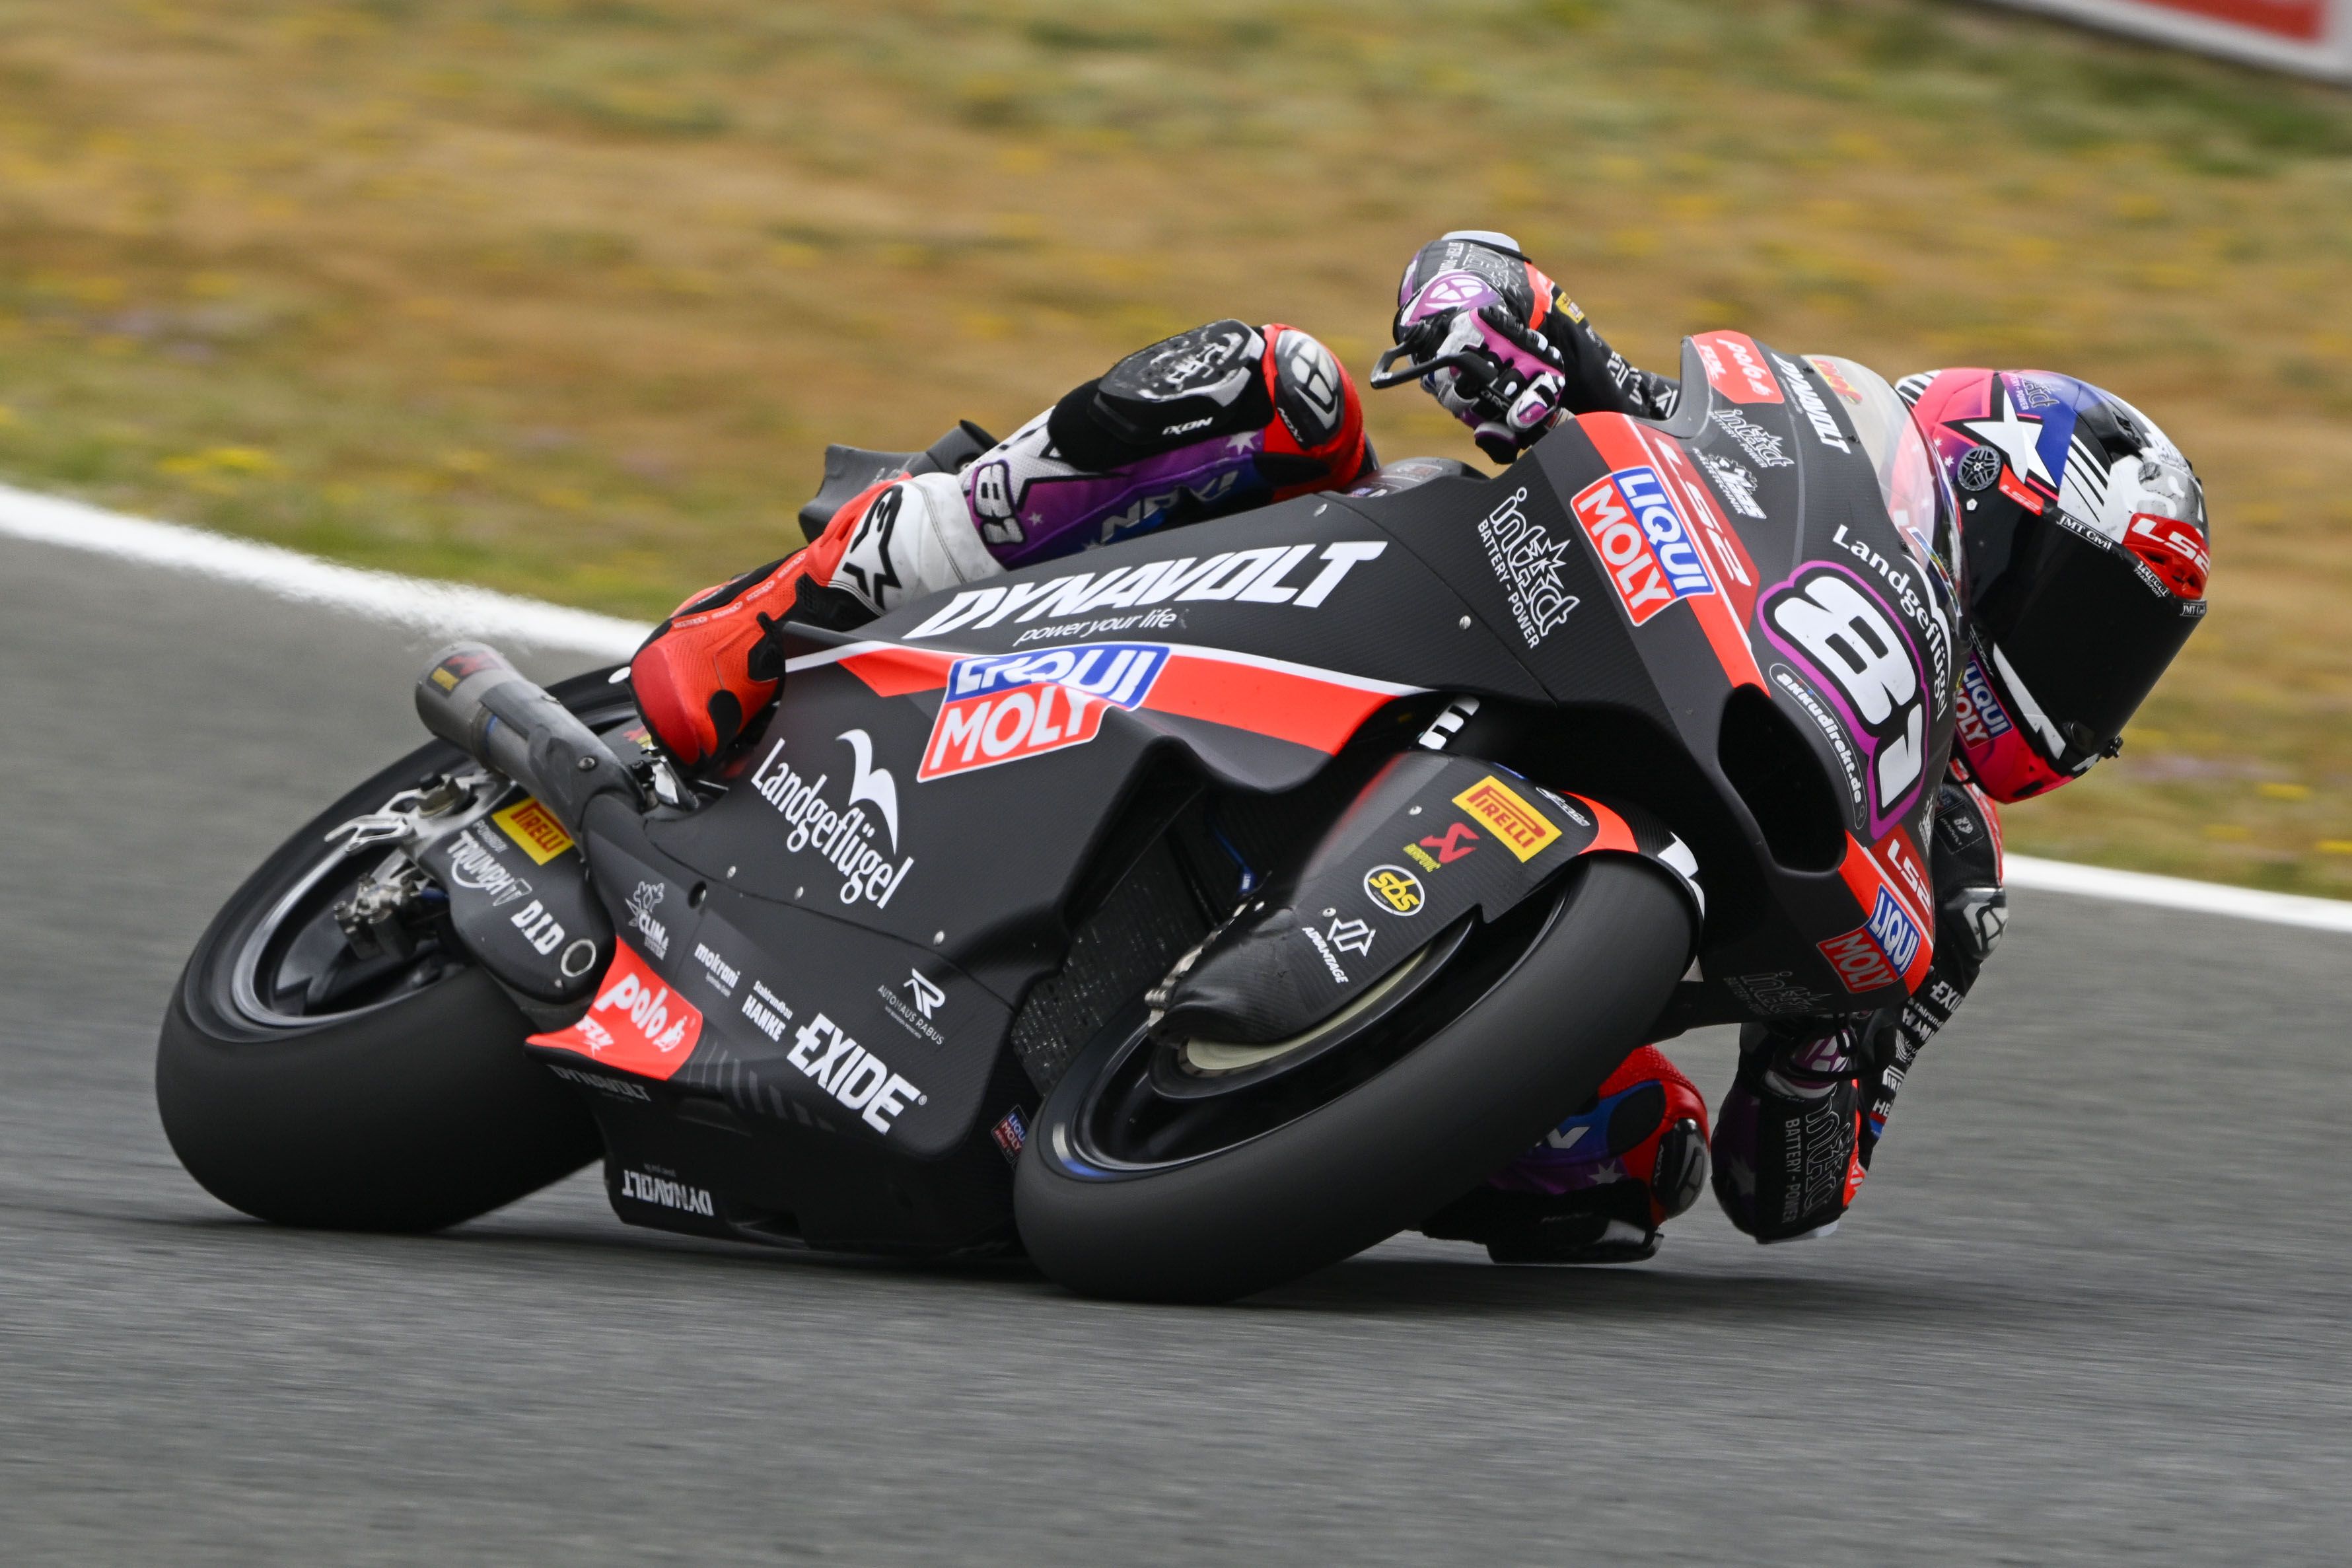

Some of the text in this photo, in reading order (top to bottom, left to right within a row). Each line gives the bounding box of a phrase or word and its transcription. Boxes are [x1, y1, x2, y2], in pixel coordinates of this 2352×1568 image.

[1715, 338, 1767, 380] polo
[1771, 352, 1851, 454] DYNAVOLT
[2000, 484, 2042, 513] LS2
[1577, 483, 1672, 610] MOLY
[1616, 472, 1708, 591] LIQUI
[2056, 515, 2112, 551] JMT Civil
[2132, 518, 2210, 578] LS2
[902, 541, 1388, 641] DYNAVOLT
[1478, 518, 1511, 583] BATTERY
[1507, 594, 1540, 649] POWER
[2133, 567, 2162, 598] TRANSPORT
[1013, 608, 1177, 647] power your life
[955, 649, 1158, 703] LIQUI
[1774, 576, 1923, 808] 81
[1964, 664, 2010, 735] LIQUI
[929, 686, 1098, 771] MOLY
[510, 801, 572, 854] PIRELLI
[750, 736, 915, 909] Landgeflügel
[1466, 785, 1547, 849] PIRELLI
[447, 830, 515, 896] TRIUMPH
[1369, 871, 1419, 911] sbs
[1887, 838, 1931, 916] LS2
[1301, 927, 1349, 984] ADVANTAGE
[1824, 932, 1894, 988] MOLY
[1869, 892, 1918, 973] LIQUI
[694, 942, 740, 989] mokrani
[594, 972, 668, 1039] polo
[741, 993, 787, 1043] HANKE
[878, 985, 917, 1022] AUTOHAUS
[915, 1018, 944, 1046] RABUS
[1001, 1122, 1022, 1150] MOLY
[1785, 1118, 1802, 1173] BATTERY
[622, 1168, 715, 1217] DYNAVOLT
